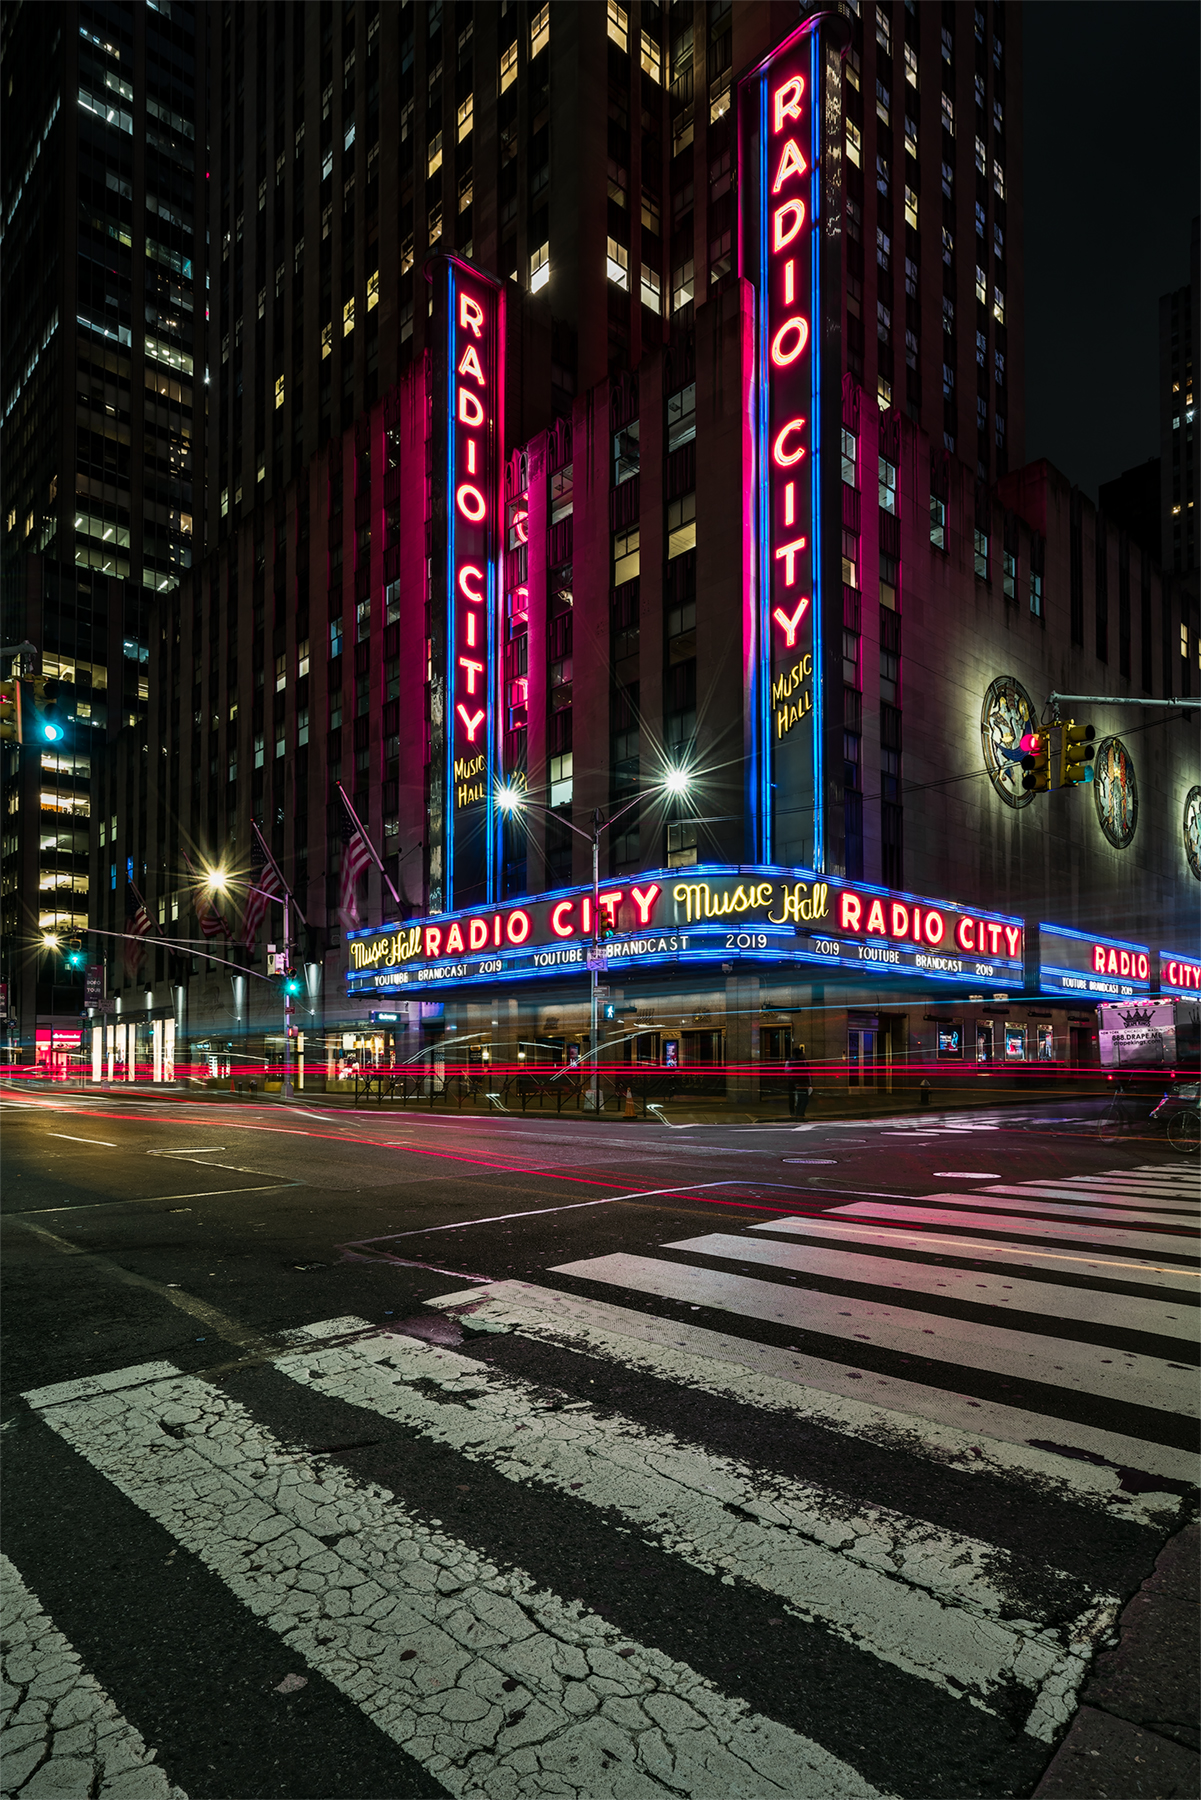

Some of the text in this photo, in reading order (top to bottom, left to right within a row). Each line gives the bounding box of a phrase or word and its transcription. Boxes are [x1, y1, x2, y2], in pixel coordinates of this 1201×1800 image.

[772, 76, 808, 646] RADIO CITY
[457, 293, 486, 741] RADIO CITY
[350, 884, 660, 969] Music Hall RADIO CITY
[673, 883, 829, 924] Music Hall
[841, 892, 1020, 956] RADIO CITY
[374, 972, 409, 987] YOUTUBE
[418, 964, 468, 981] BRANDCAST
[479, 960, 502, 974] 2019
[534, 948, 583, 966] YOUTUBE
[606, 936, 689, 958] BRANDCAST
[726, 934, 767, 948] 2019
[815, 940, 993, 976] 2019 YOUTUBE BRANDCAST 2019
[1094, 946, 1148, 979] RADIO
[1168, 961, 1201, 989] CITY
[1062, 977, 1134, 996] YOUTUBE BRANDCAST 2019
